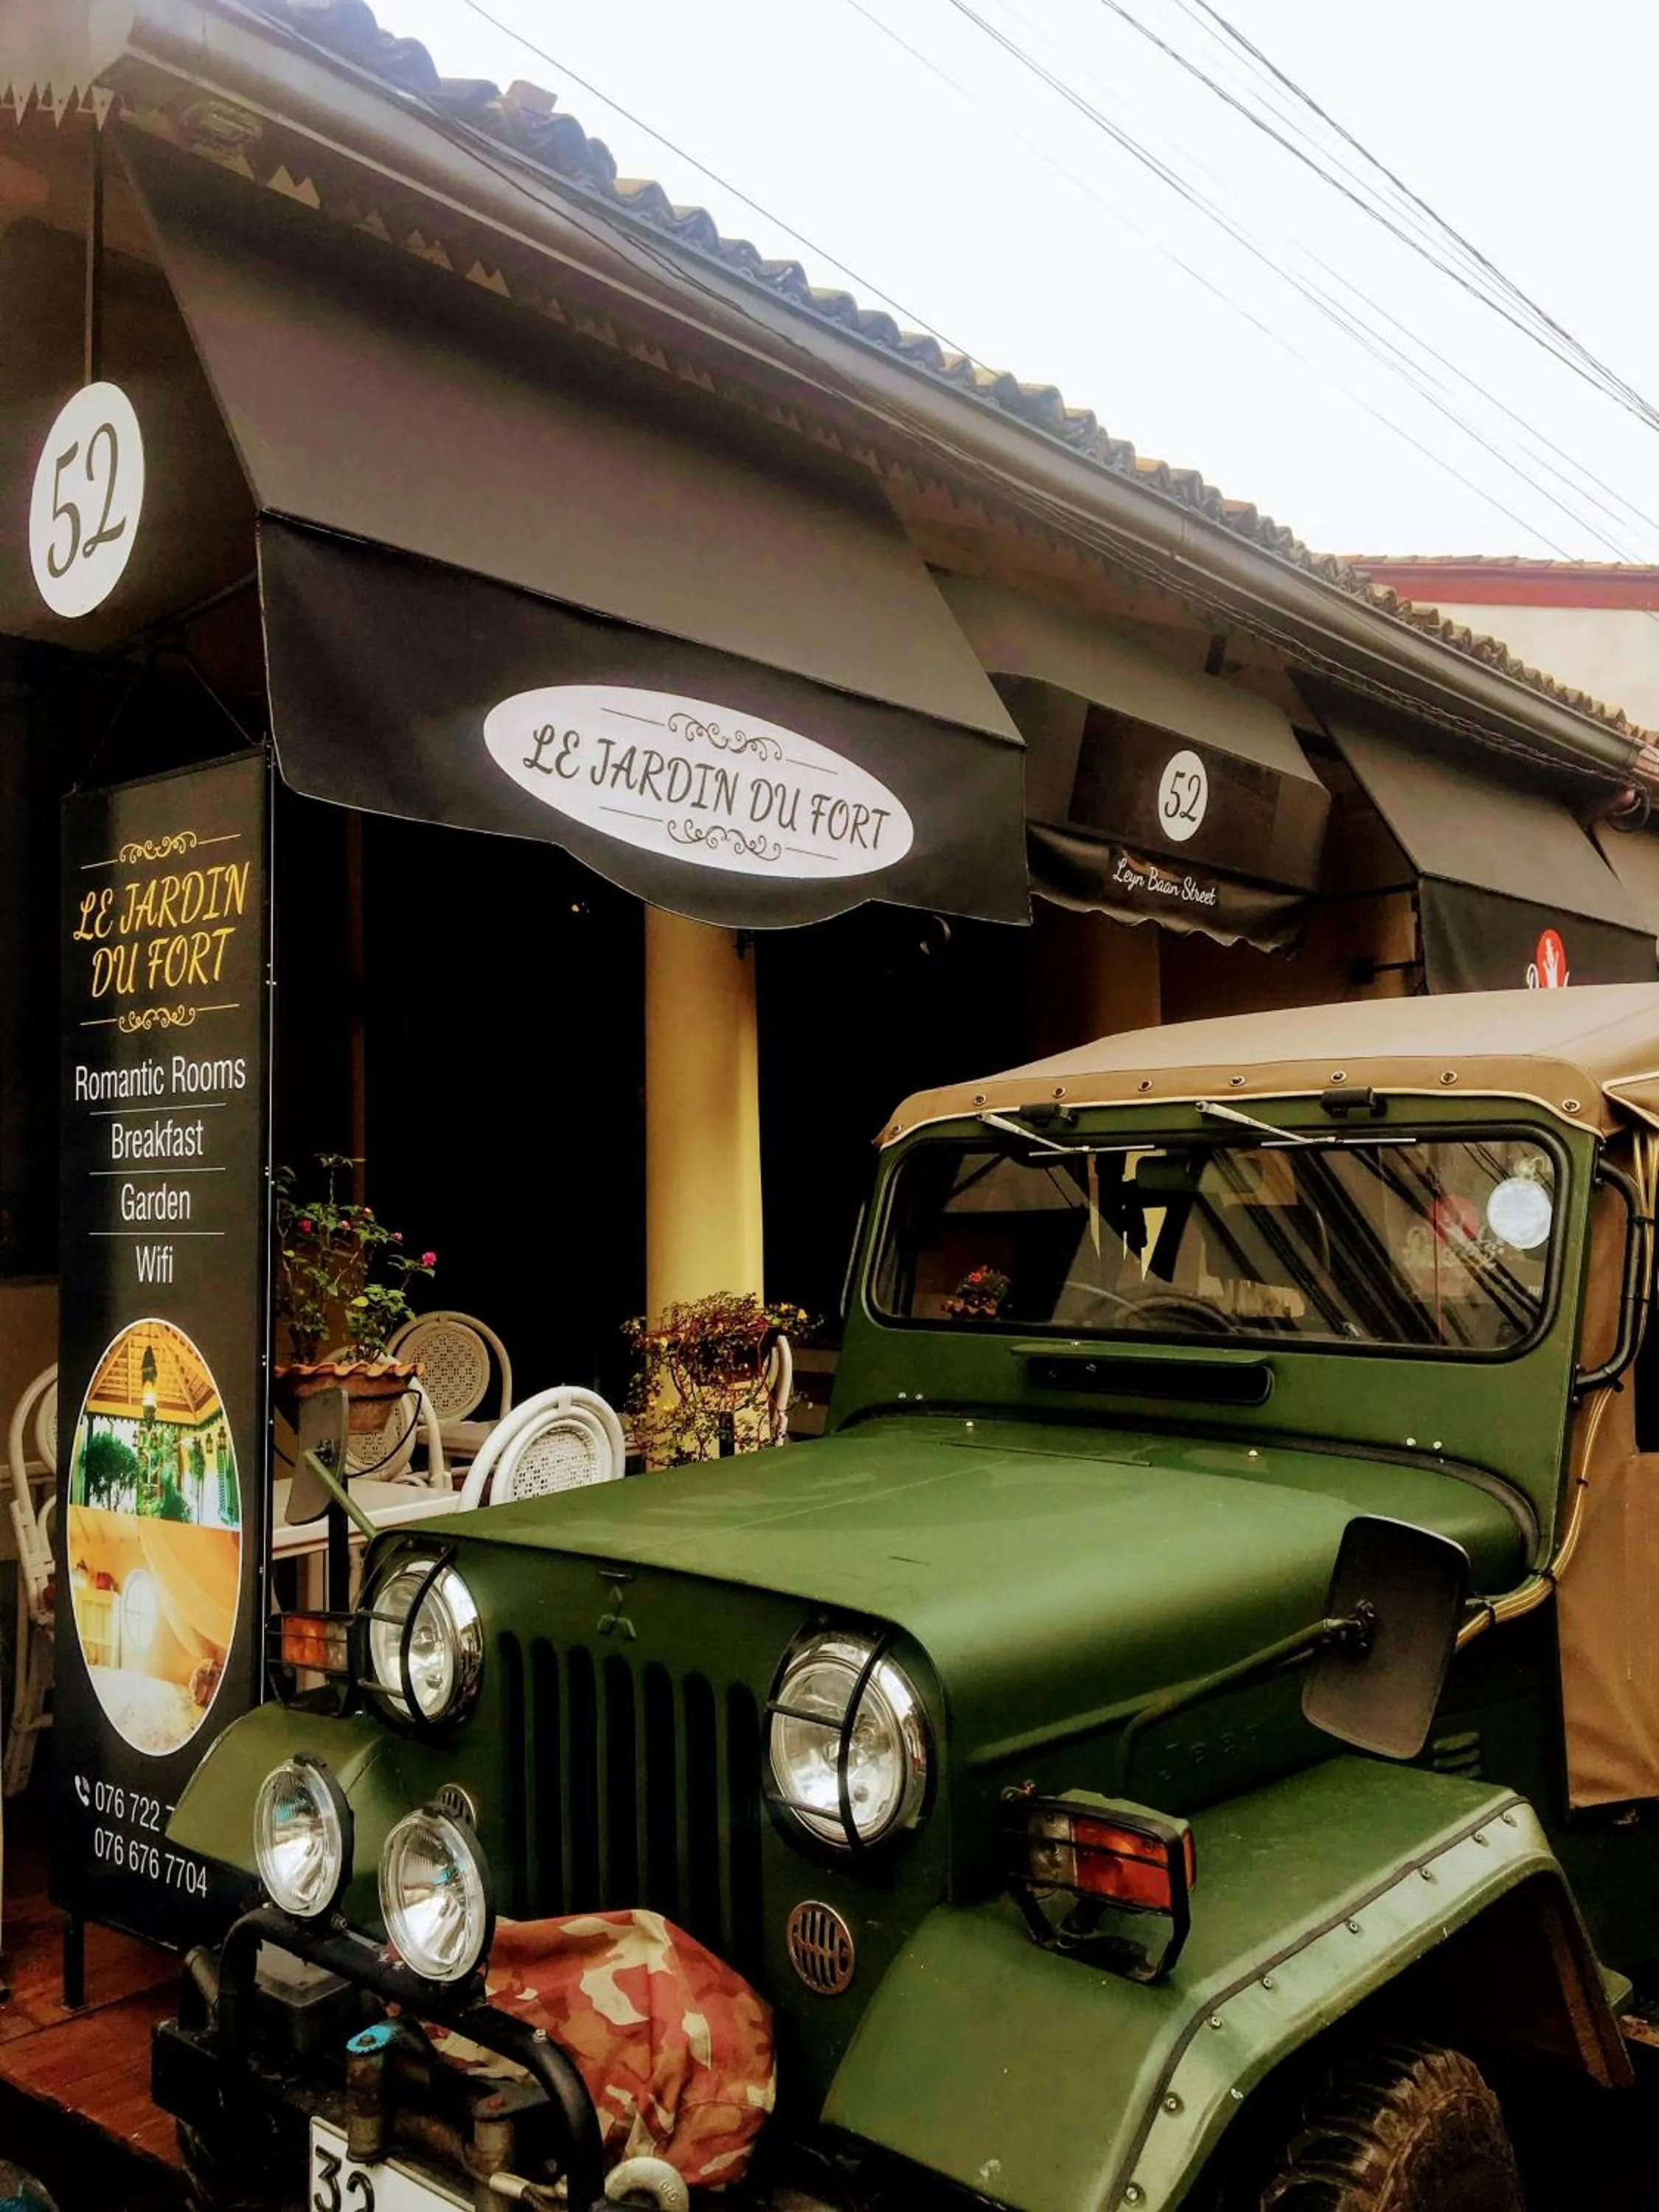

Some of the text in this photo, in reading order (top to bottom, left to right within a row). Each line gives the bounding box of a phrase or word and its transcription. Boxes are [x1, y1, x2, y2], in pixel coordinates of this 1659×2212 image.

[47, 422, 126, 578] 52
[522, 723, 891, 850] LE JARDIN DU FORT
[1164, 771, 1202, 823] 52
[74, 860, 251, 941] LE JARDIN
[1113, 857, 1217, 905] Leyn Baan Street
[91, 927, 237, 998] DU FORT
[74, 1055, 246, 1102] Romantic Rooms
[111, 1119, 204, 1160] Breakfast
[120, 1182, 192, 1222] Garden
[135, 1245, 174, 1284] Wifi
[95, 1781, 161, 1832] 076 722
[94, 1827, 208, 1899] 076 676 7704
